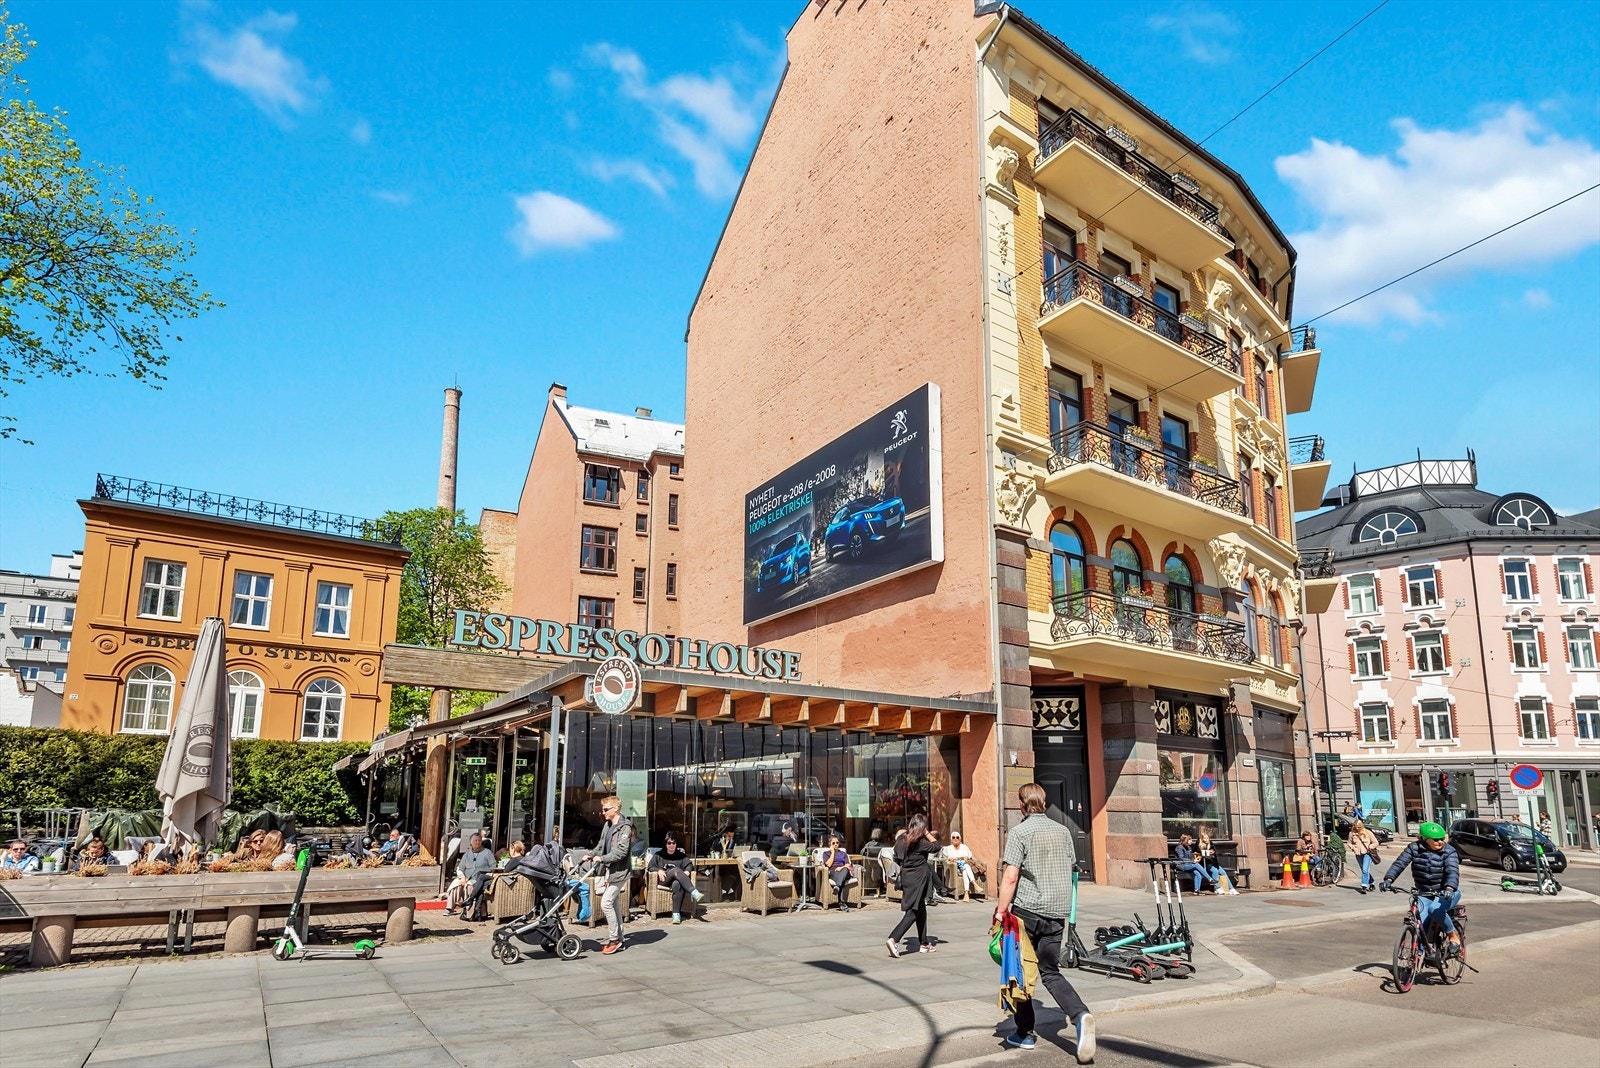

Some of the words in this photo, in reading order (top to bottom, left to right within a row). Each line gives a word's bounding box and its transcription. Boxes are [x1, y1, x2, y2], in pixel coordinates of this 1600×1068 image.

[884, 431, 918, 454] PEUGEOT
[749, 486, 775, 510] NYHET!
[749, 494, 782, 522] PEUGEOT
[748, 517, 767, 534] 100%
[767, 490, 813, 525] ELEKTRISKE!
[145, 634, 198, 651] BERT
[238, 644, 257, 657] O.
[264, 646, 338, 664] STEEN
[449, 608, 671, 666] ESPRESSO
[679, 637, 803, 681] HOUSE
[596, 659, 632, 683] ESPRESSO
[600, 695, 628, 710] HOUSE
[189, 765, 209, 774] HO
